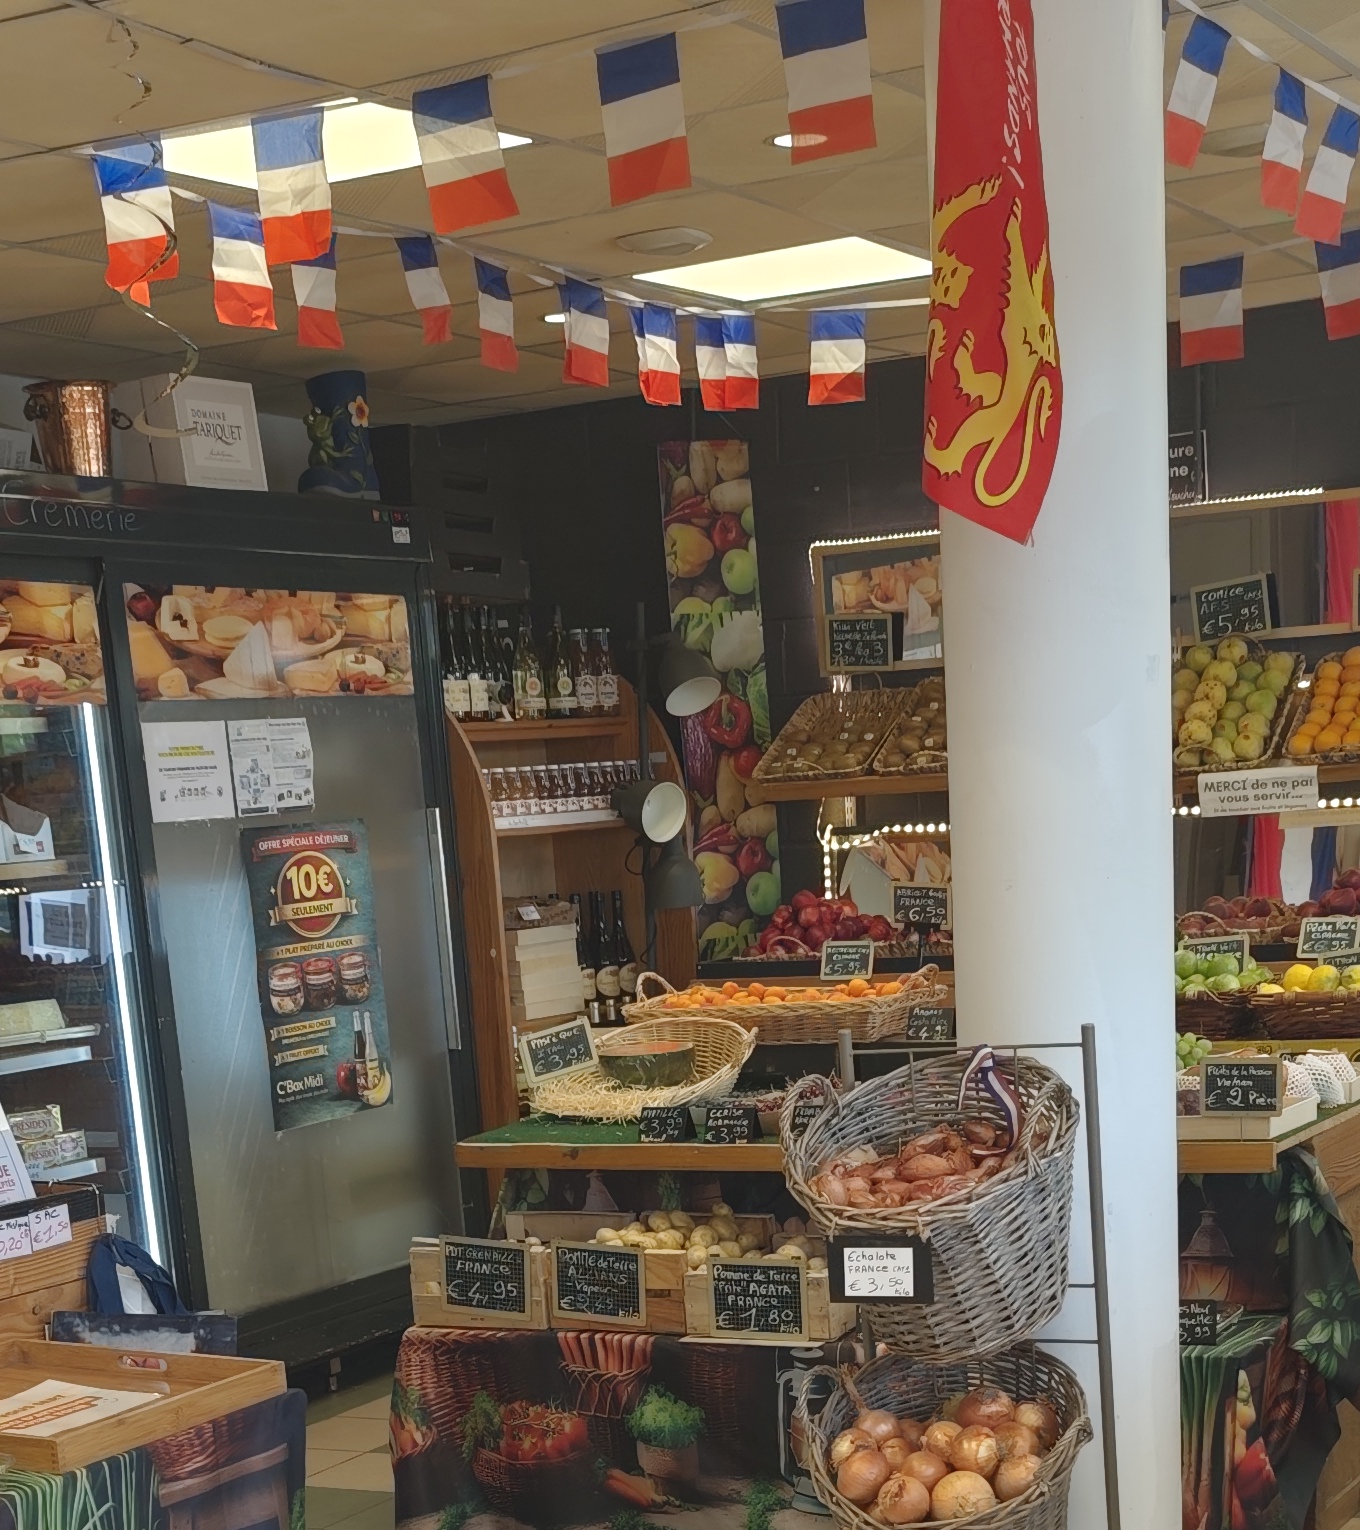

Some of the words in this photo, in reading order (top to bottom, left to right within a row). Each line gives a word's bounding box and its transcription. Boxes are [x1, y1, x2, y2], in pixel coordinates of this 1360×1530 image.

[191, 408, 226, 421] DOMAINE
[193, 421, 242, 446] TARIQUET
[1204, 777, 1248, 793] MERCI
[1251, 778, 1267, 790] de
[1272, 778, 1287, 788] ne
[1219, 793, 1249, 803] vous
[259, 840, 281, 850] OFFRE
[282, 836, 313, 847] SPÉCIALE
[315, 833, 349, 845] DÉJEUNER
[286, 864, 333, 899] 10€
[291, 903, 333, 916] SEULEMENT
[304, 1073, 324, 1089] Midi
[749, 1283, 791, 1296] AGATA
